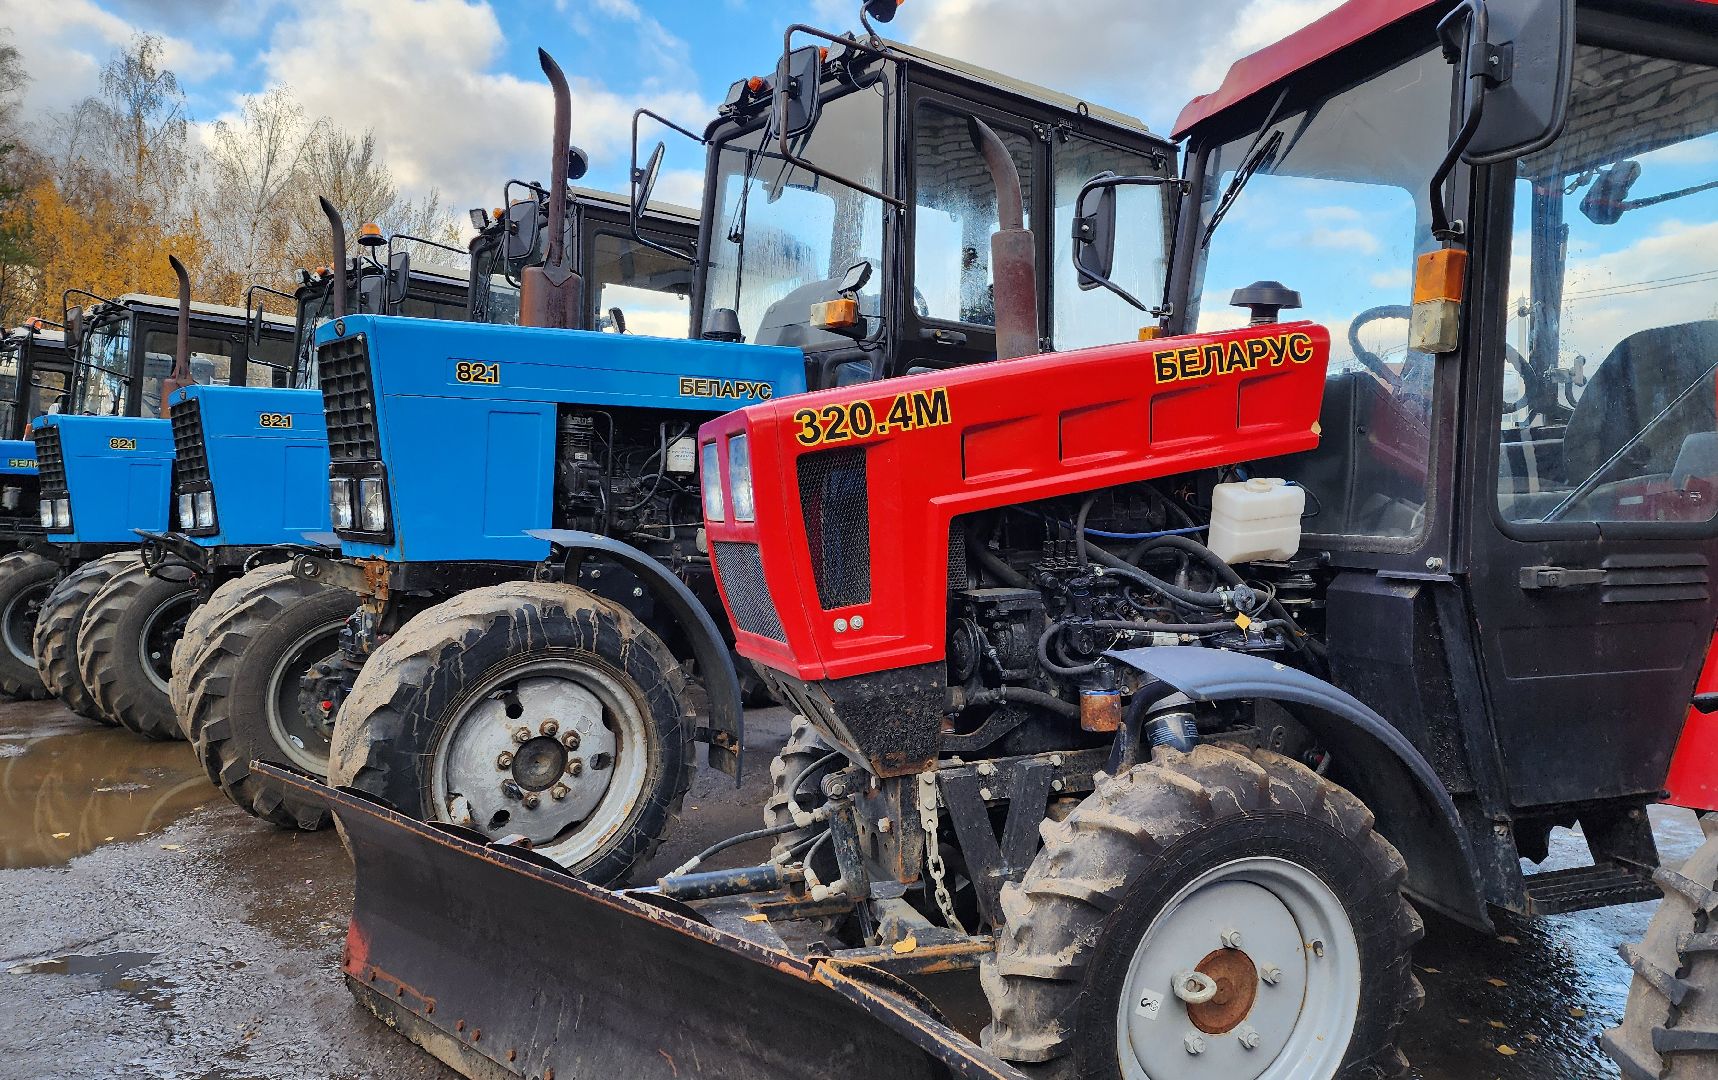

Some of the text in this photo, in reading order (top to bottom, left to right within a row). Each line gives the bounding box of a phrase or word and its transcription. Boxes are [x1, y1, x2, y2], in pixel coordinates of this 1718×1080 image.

[1153, 332, 1314, 384] БЕЛАРУС
[456, 361, 500, 384] 82.1
[679, 376, 773, 400] БЕЛАРУС
[260, 412, 293, 428] 82.1
[794, 386, 952, 447] 320.4М
[109, 437, 136, 450] 82.1
